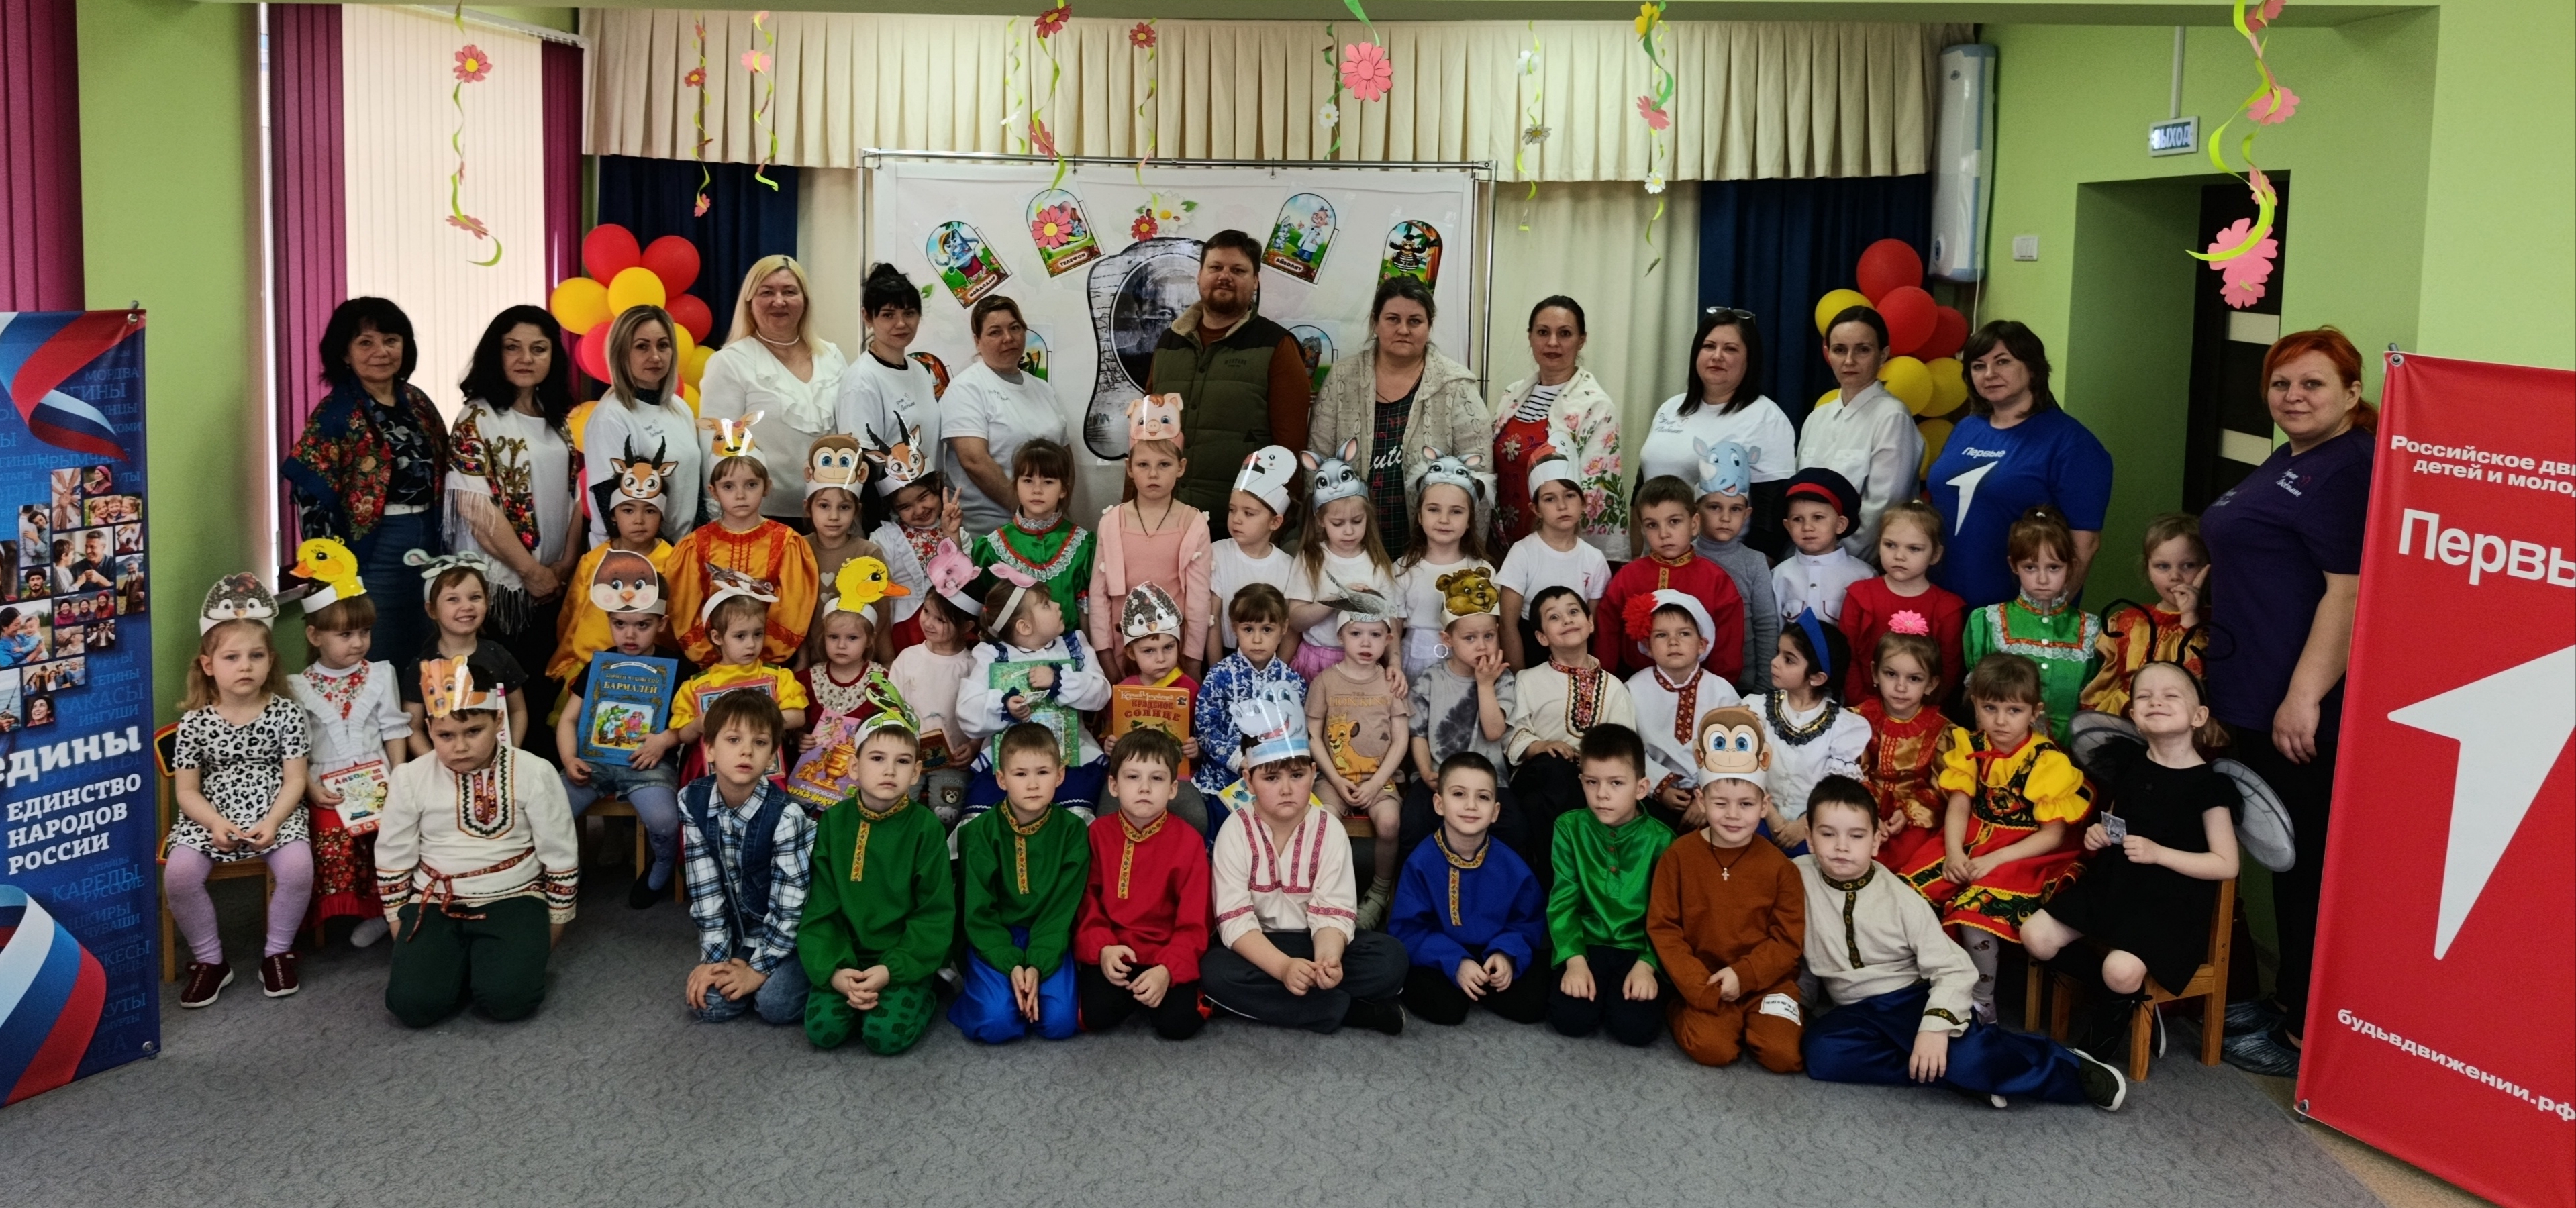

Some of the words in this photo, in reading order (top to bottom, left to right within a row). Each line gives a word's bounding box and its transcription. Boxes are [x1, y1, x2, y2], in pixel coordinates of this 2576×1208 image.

[2152, 125, 2191, 149] ВЫХОД
[1060, 252, 1086, 267] ТЕЛЕФОН
[1276, 258, 1303, 272] АЙБОЛИТ
[969, 276, 996, 298] МОЙДОДЫР
[85, 366, 140, 382] МОРДВА
[1961, 447, 2006, 459] Первые
[2391, 435, 2535, 470] Российское
[2413, 459, 2482, 481] детей
[2487, 470, 2502, 483] и
[2508, 474, 2576, 498] моло
[603, 681, 658, 694] БАРМАЛЕЙ
[79, 704, 139, 727] ИНГУШИ
[1124, 709, 1181, 722] СОЛНЦЕ
[1132, 699, 1174, 710] КРАДЕНОЕ
[7, 773, 142, 822] ЕДИНСТВО
[7, 802, 128, 849] НАРОДОВ
[8, 832, 110, 875] РОССИИ
[52, 864, 140, 903] КАРЕЛЫ
[2338, 1009, 2576, 1122] будьвдвижении.рф
